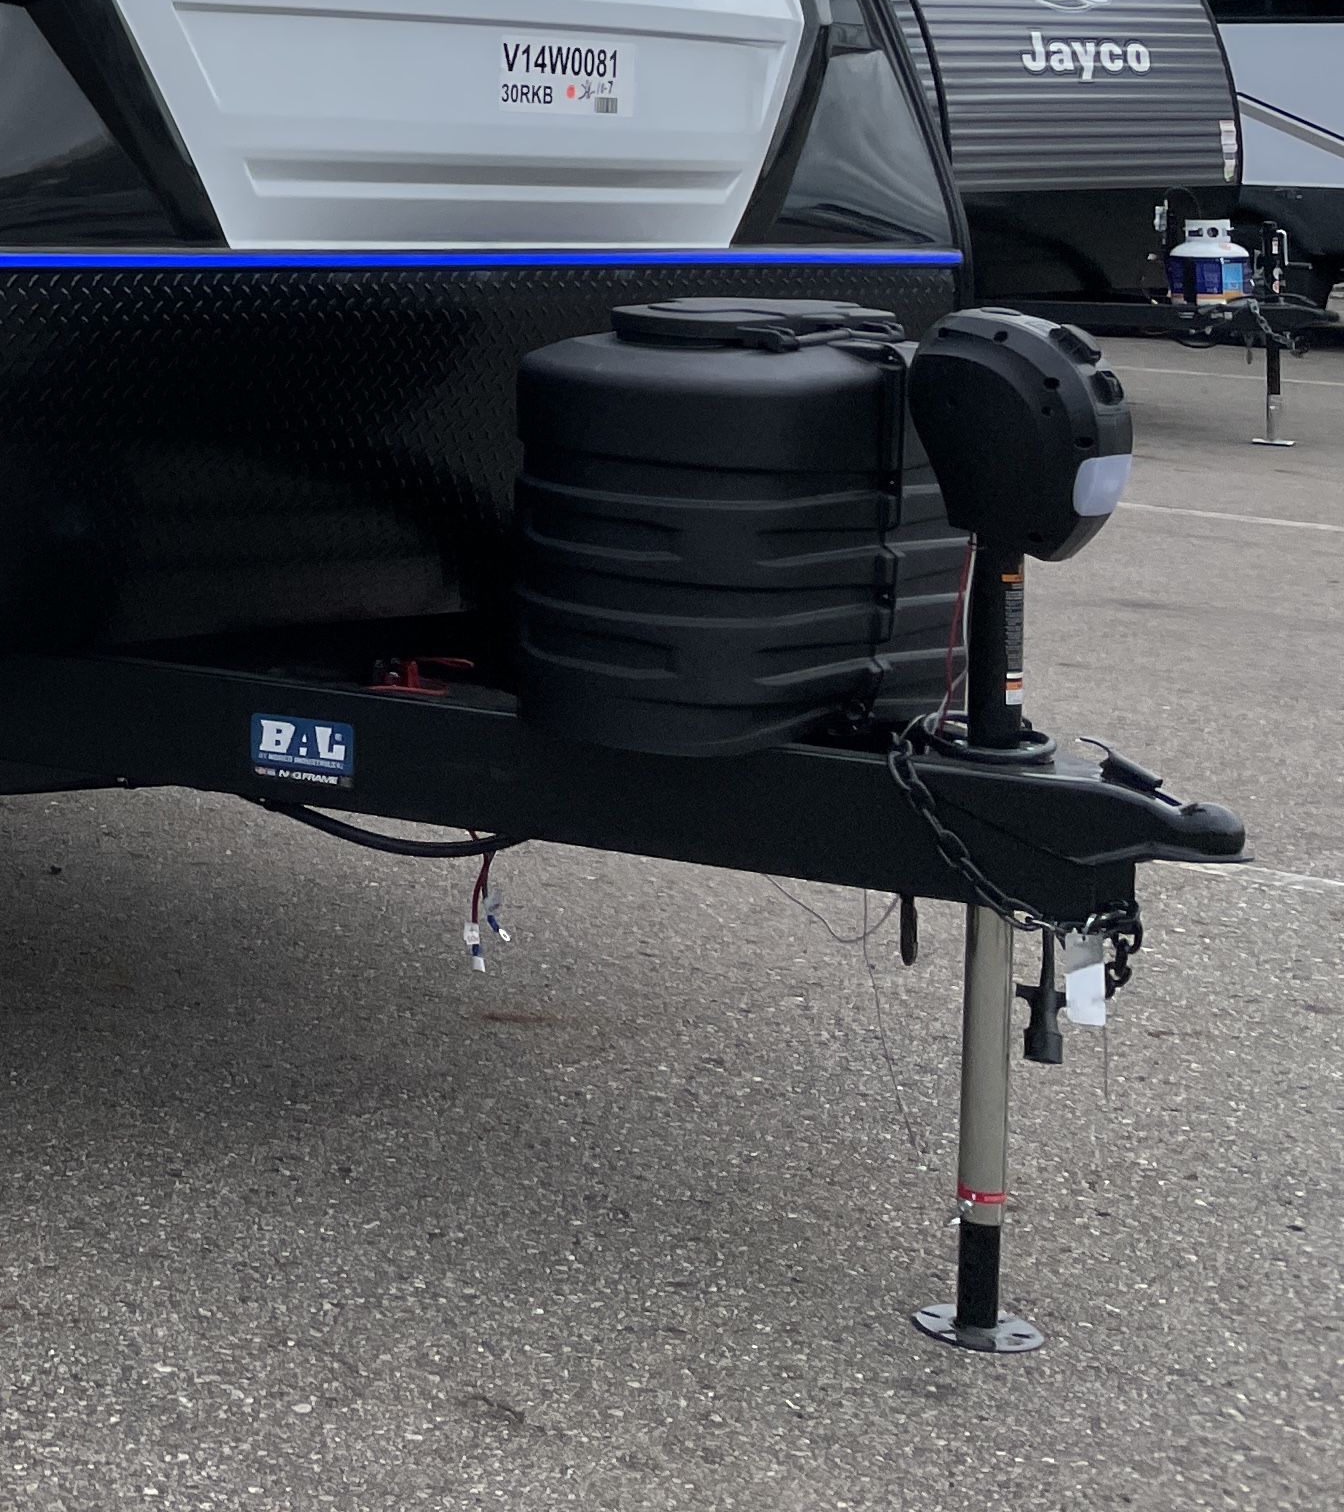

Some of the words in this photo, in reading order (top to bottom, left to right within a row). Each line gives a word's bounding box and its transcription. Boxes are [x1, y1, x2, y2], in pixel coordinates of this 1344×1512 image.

[503, 42, 618, 79] V14W0081
[1021, 30, 1152, 82] Jayco
[501, 83, 553, 105] 30RKB
[259, 719, 346, 761] BAL
